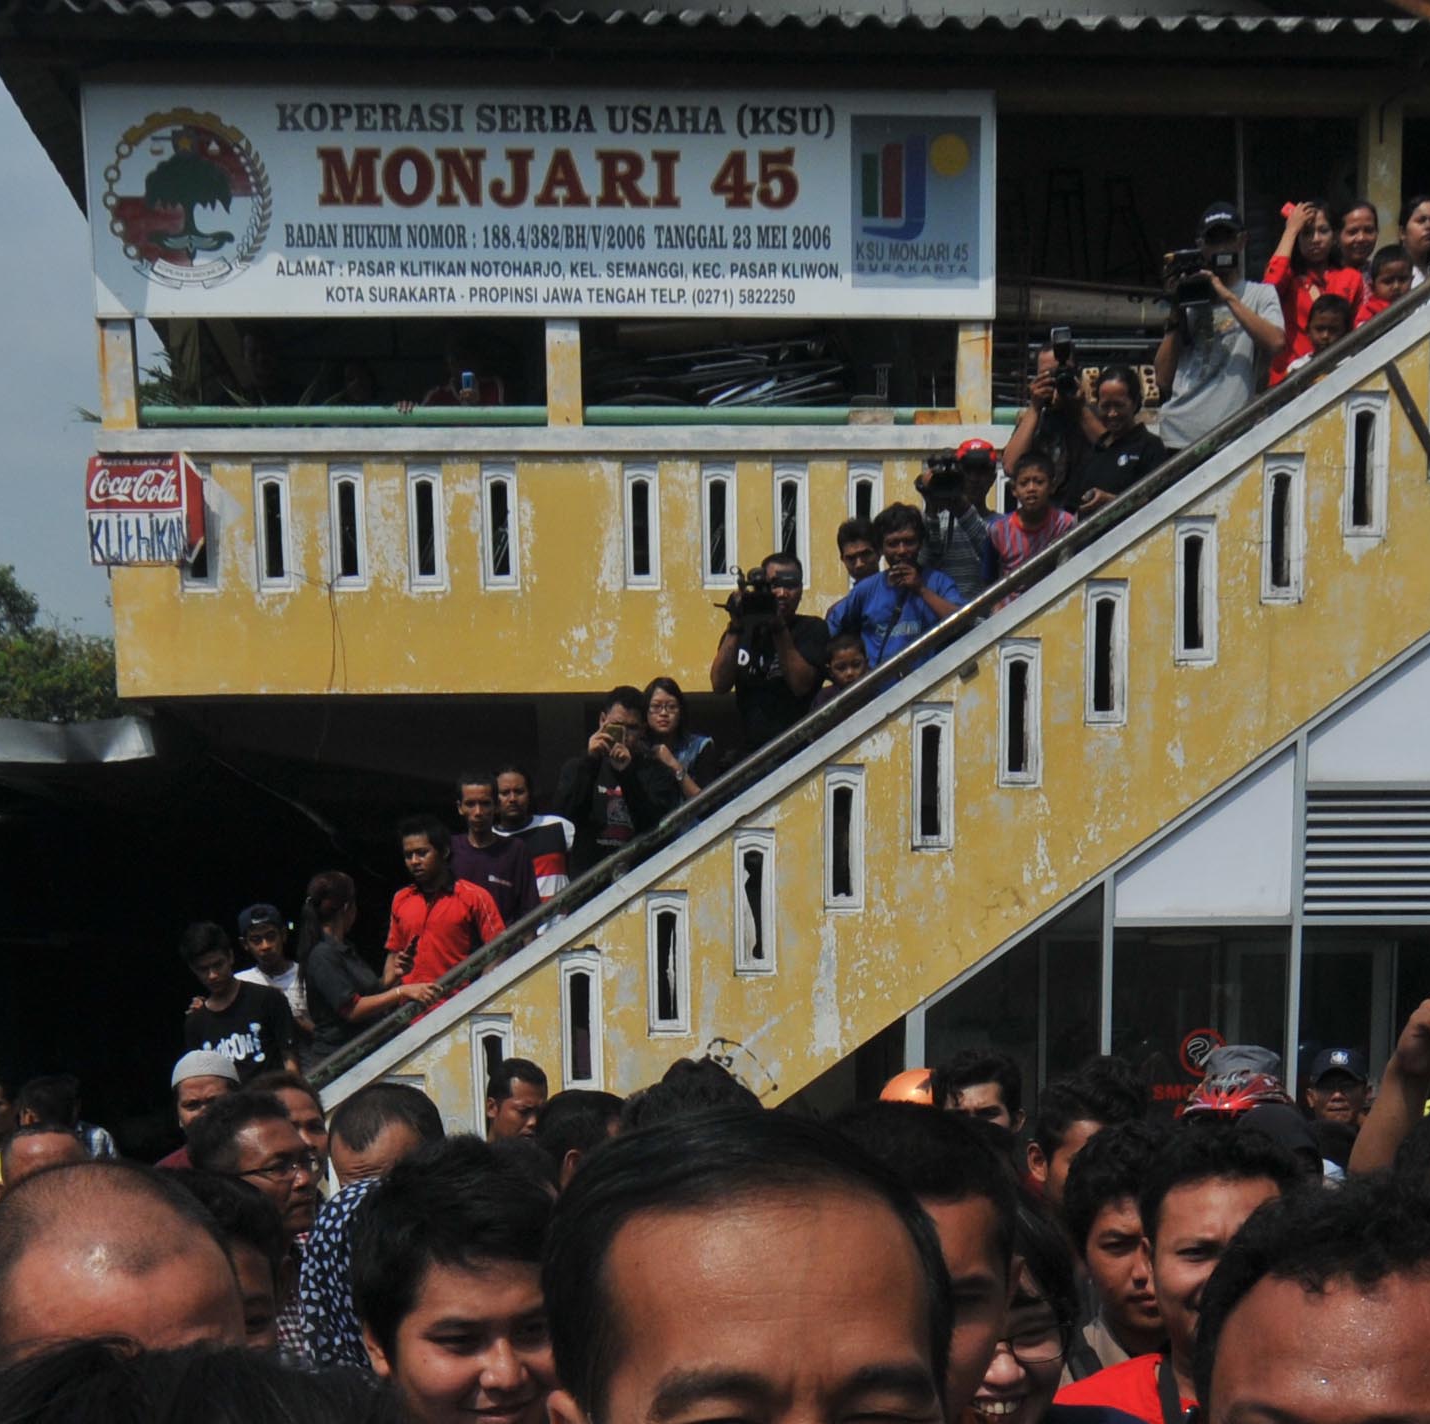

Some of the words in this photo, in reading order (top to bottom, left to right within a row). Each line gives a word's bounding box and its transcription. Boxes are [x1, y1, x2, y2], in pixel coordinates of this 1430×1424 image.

[276, 103, 464, 133] KOPERASI
[476, 103, 596, 134] SERBA
[605, 104, 726, 135] USAHA
[737, 103, 835, 139] (KSU)
[316, 146, 681, 209] MONJARI
[710, 146, 799, 210] 45
[285, 223, 338, 249] BADAN
[342, 223, 403, 249] HUKUM
[406, 223, 468, 249] NOMOR
[482, 223, 646, 252] 188.4/382/BH/V/2006
[654, 224, 727, 250] TANGGAL
[732, 225, 751, 250] 23
[756, 225, 788, 250] MEI
[792, 225, 831, 250] 2006
[856, 241, 884, 261] KSU
[889, 242, 950, 262] MONJARI
[953, 242, 969, 262] 45
[276, 260, 335, 277] ALAMAT
[347, 260, 396, 277] PASAR
[400, 261, 467, 278] KLITIKAN
[470, 261, 566, 281] NOTOHARJO,
[570, 262, 602, 278] KEL.
[606, 262, 688, 282] SEMANGGI,
[692, 262, 725, 279] KEC.
[730, 263, 777, 279] PASAR
[781, 263, 843, 282] KLIWON,
[325, 286, 365, 302] KOTA
[370, 286, 456, 303] SURAKARTA
[469, 287, 538, 303] PROPINSI
[542, 287, 583, 303] JAWA
[587, 287, 646, 304] TENGAH
[651, 288, 687, 304] TELP.
[691, 288, 734, 308] (0271)
[738, 289, 796, 305] 5822250
[89, 468, 179, 503] Coca-Cola
